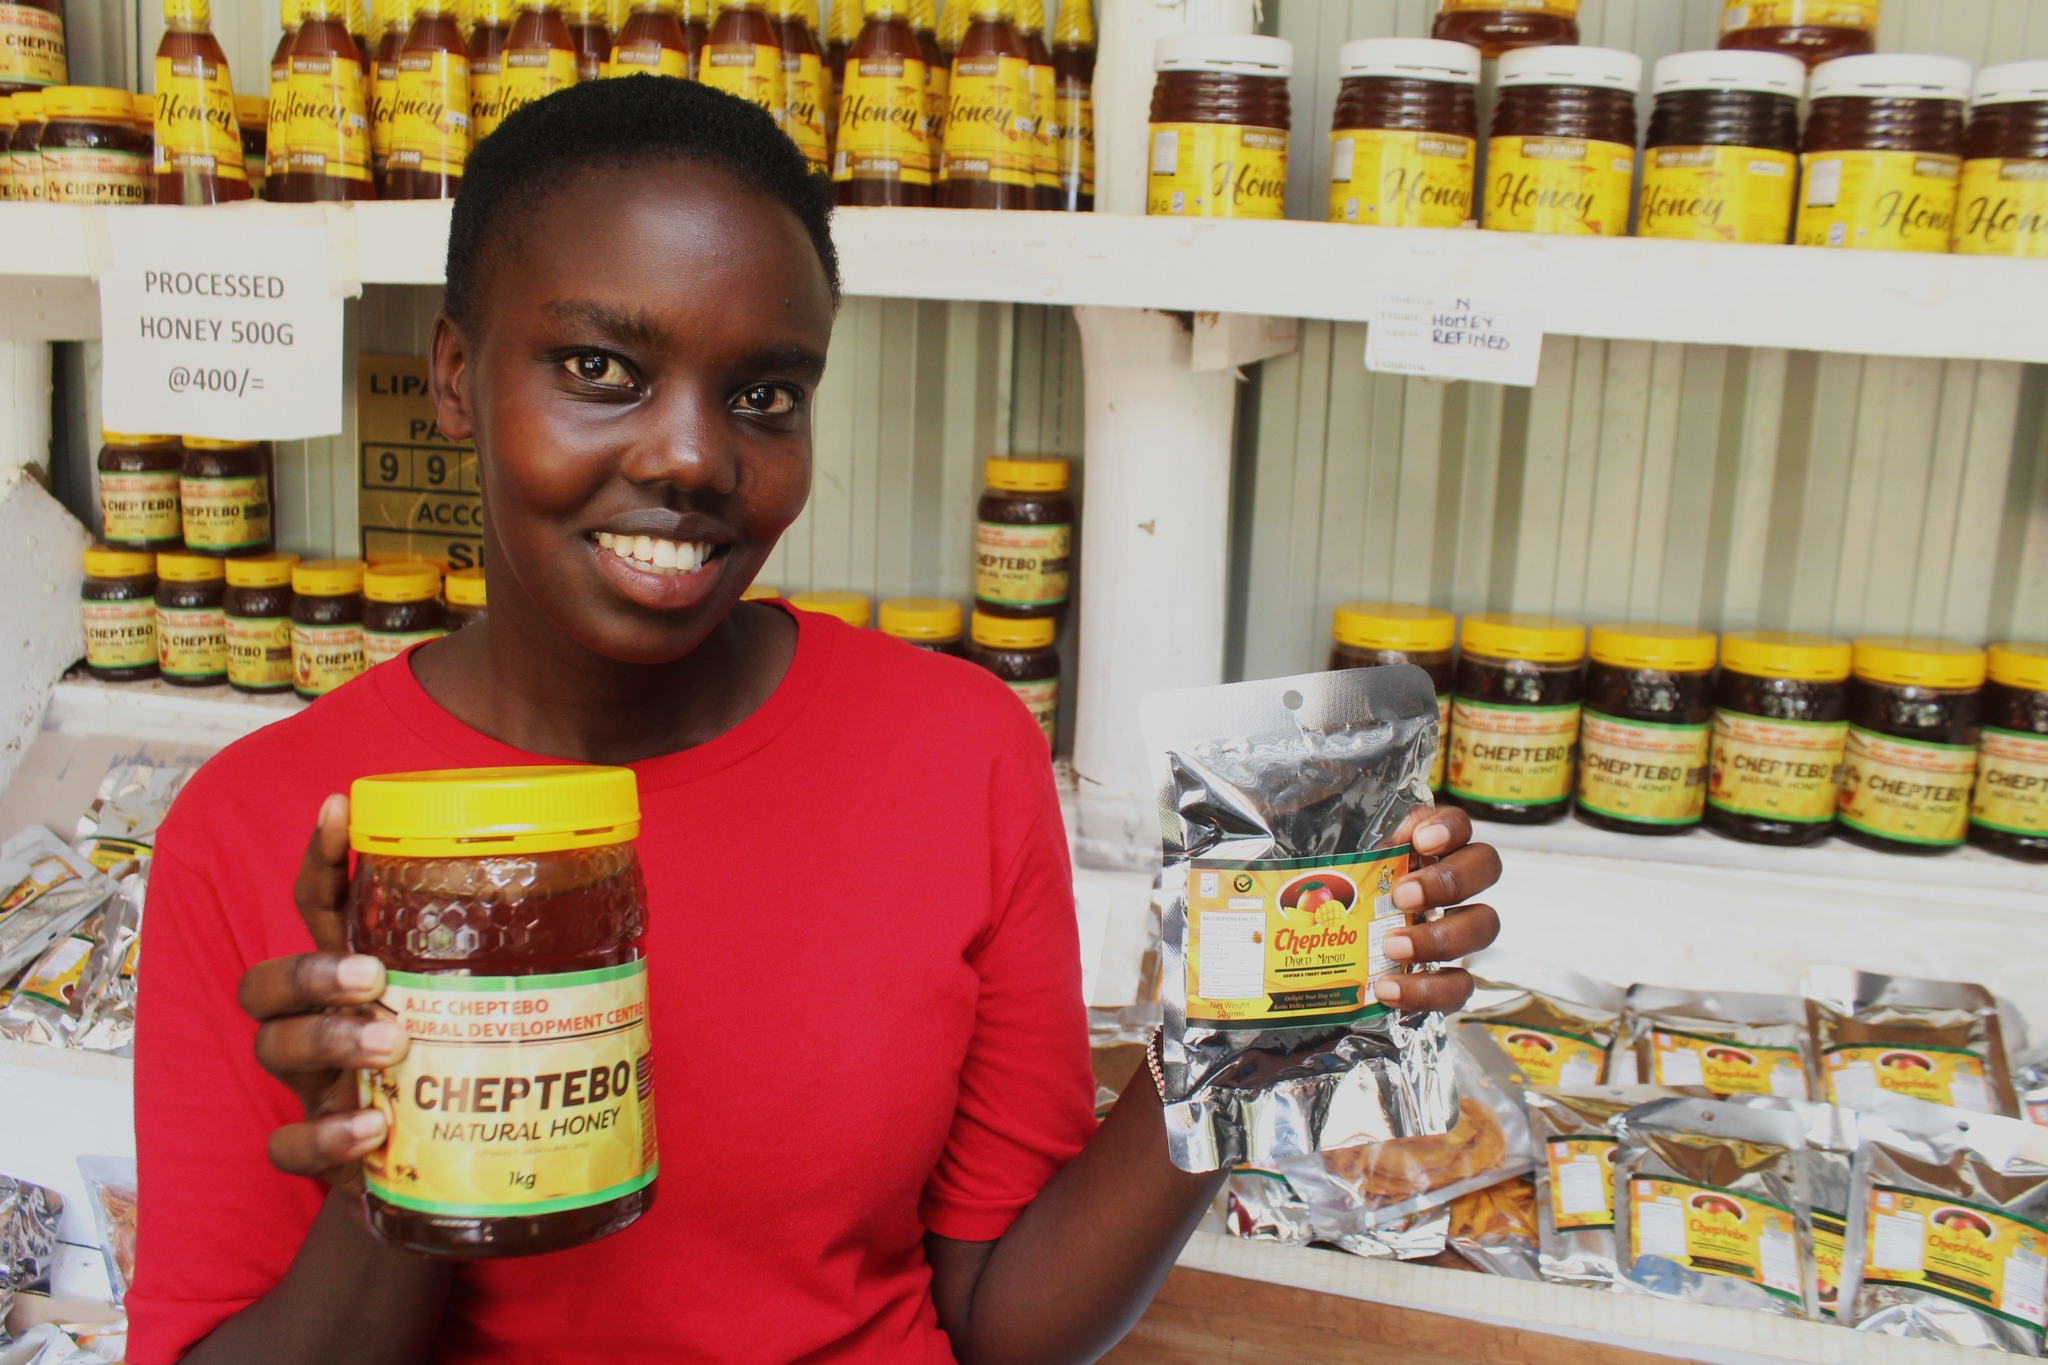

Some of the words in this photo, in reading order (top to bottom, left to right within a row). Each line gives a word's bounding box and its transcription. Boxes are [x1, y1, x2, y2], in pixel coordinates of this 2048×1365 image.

[157, 92, 231, 131] Honey
[842, 94, 917, 130] Honey
[1497, 172, 1596, 217] Honey
[1641, 184, 1726, 228] Honey
[145, 270, 285, 299] PROCESSED
[140, 316, 222, 342] HONEY
[231, 321, 294, 346] 500G
[1432, 328, 1511, 351] REFINED
[168, 366, 264, 397] @400/=
[108, 497, 174, 511] CHEPTEBO
[90, 624, 153, 639] CHEPTEBO
[173, 633, 226, 647] CHEPTE
[1472, 742, 1566, 764] CHEPTEBO
[1733, 754, 1829, 779] CHEPTEBO
[1587, 753, 1682, 782] CHEPTEBO
[1202, 915, 1237, 923] NUTRITION
[1274, 924, 1358, 955] Cheptebo
[405, 997, 443, 1015] A.I.C
[448, 998, 549, 1016] CHEPTEBO
[406, 1018, 463, 1038] RURAL
[467, 1012, 604, 1038] DEVELOPMENT
[606, 1000, 645, 1026] CENTRE
[1210, 1001, 1224, 1009] Net
[1224, 1001, 1250, 1011] Weight
[1216, 1010, 1246, 1019] 50grms
[414, 1059, 632, 1114] CHEPTEBO
[432, 1121, 541, 1143] NATURAL
[549, 1106, 622, 1139] HONEY
[508, 1170, 537, 1190] 1kg
[1688, 1218, 1750, 1242] Cheptebo
[1927, 1234, 1995, 1262] Cheptebo
